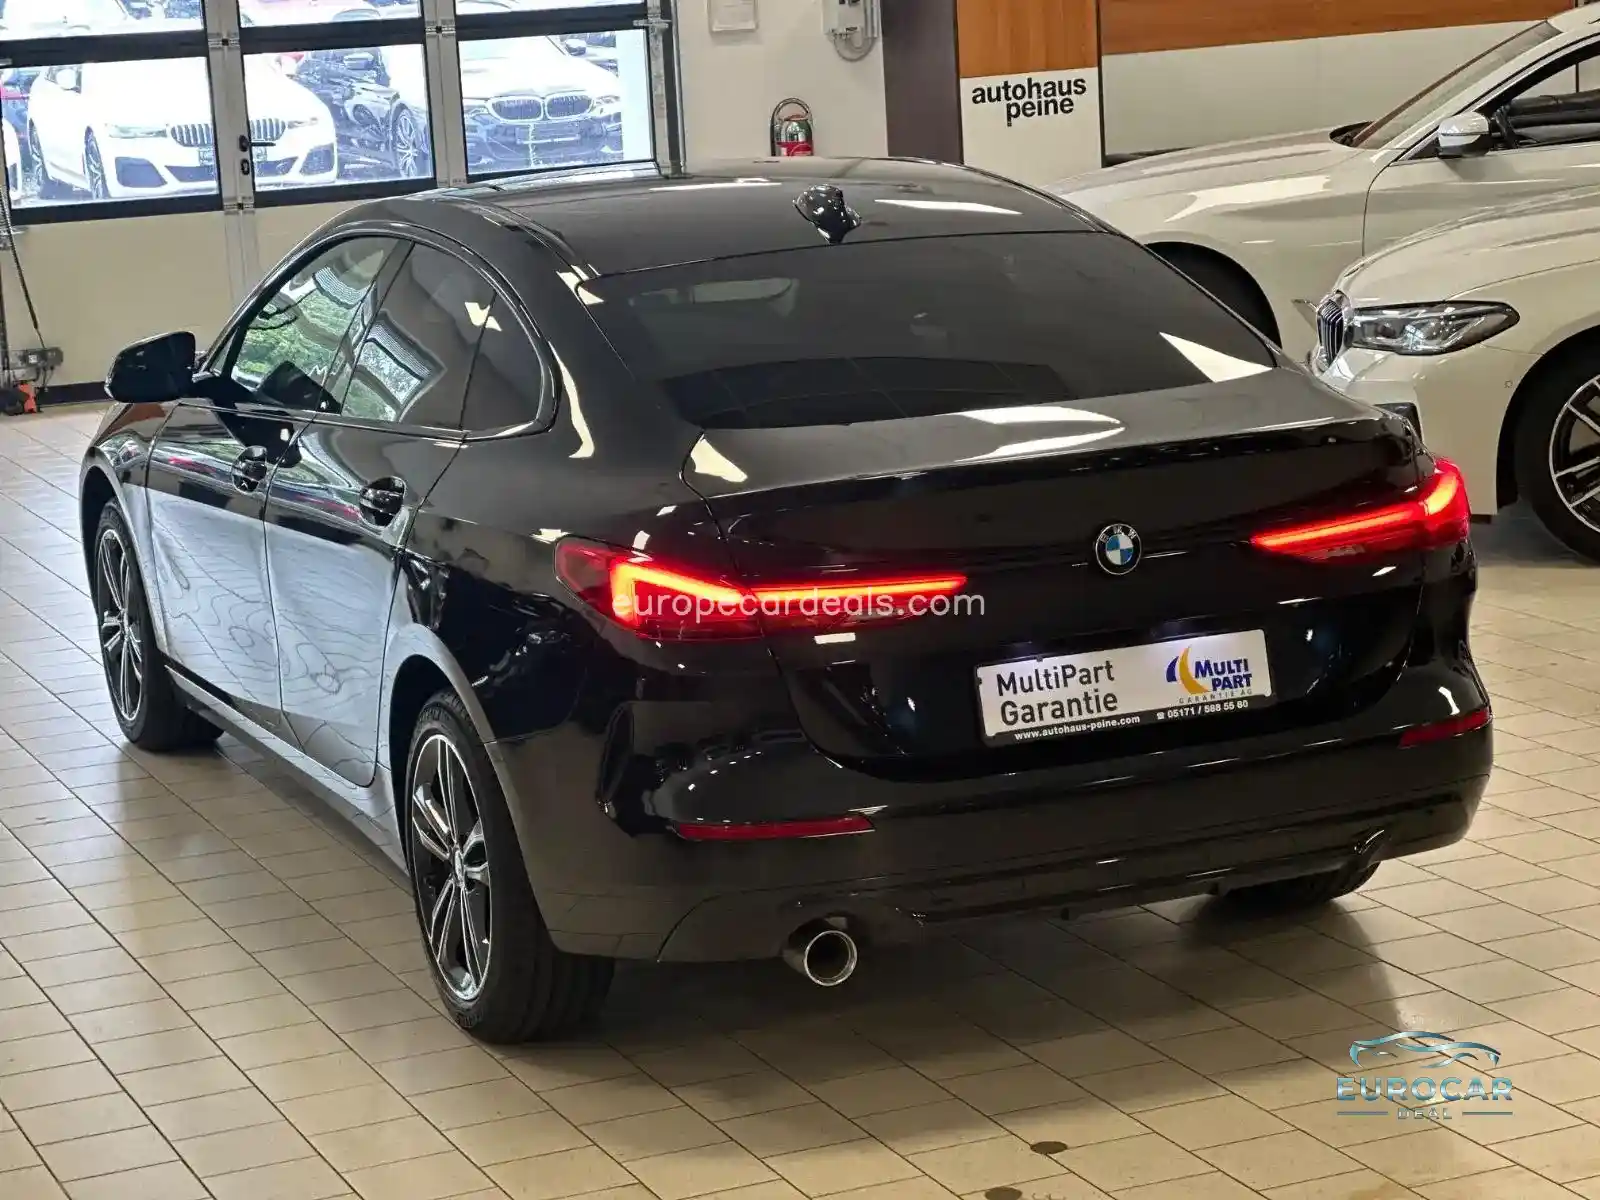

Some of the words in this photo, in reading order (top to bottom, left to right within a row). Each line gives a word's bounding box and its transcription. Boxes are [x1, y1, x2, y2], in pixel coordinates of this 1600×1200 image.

[972, 77, 1087, 104] autohaus
[1006, 97, 1074, 127] peine
[1100, 525, 1137, 543] BMW
[996, 660, 1115, 696] MultiPart
[1194, 658, 1249, 679] MULTI
[1211, 673, 1252, 691] PART
[1001, 688, 1118, 726] Garantie
[1178, 690, 1234, 704] GARANTIE
[1240, 688, 1253, 696] AG
[1167, 707, 1195, 719] 05171
[1223, 702, 1235, 711] 55
[1014, 715, 1140, 740] www.autohaus-peine.com
